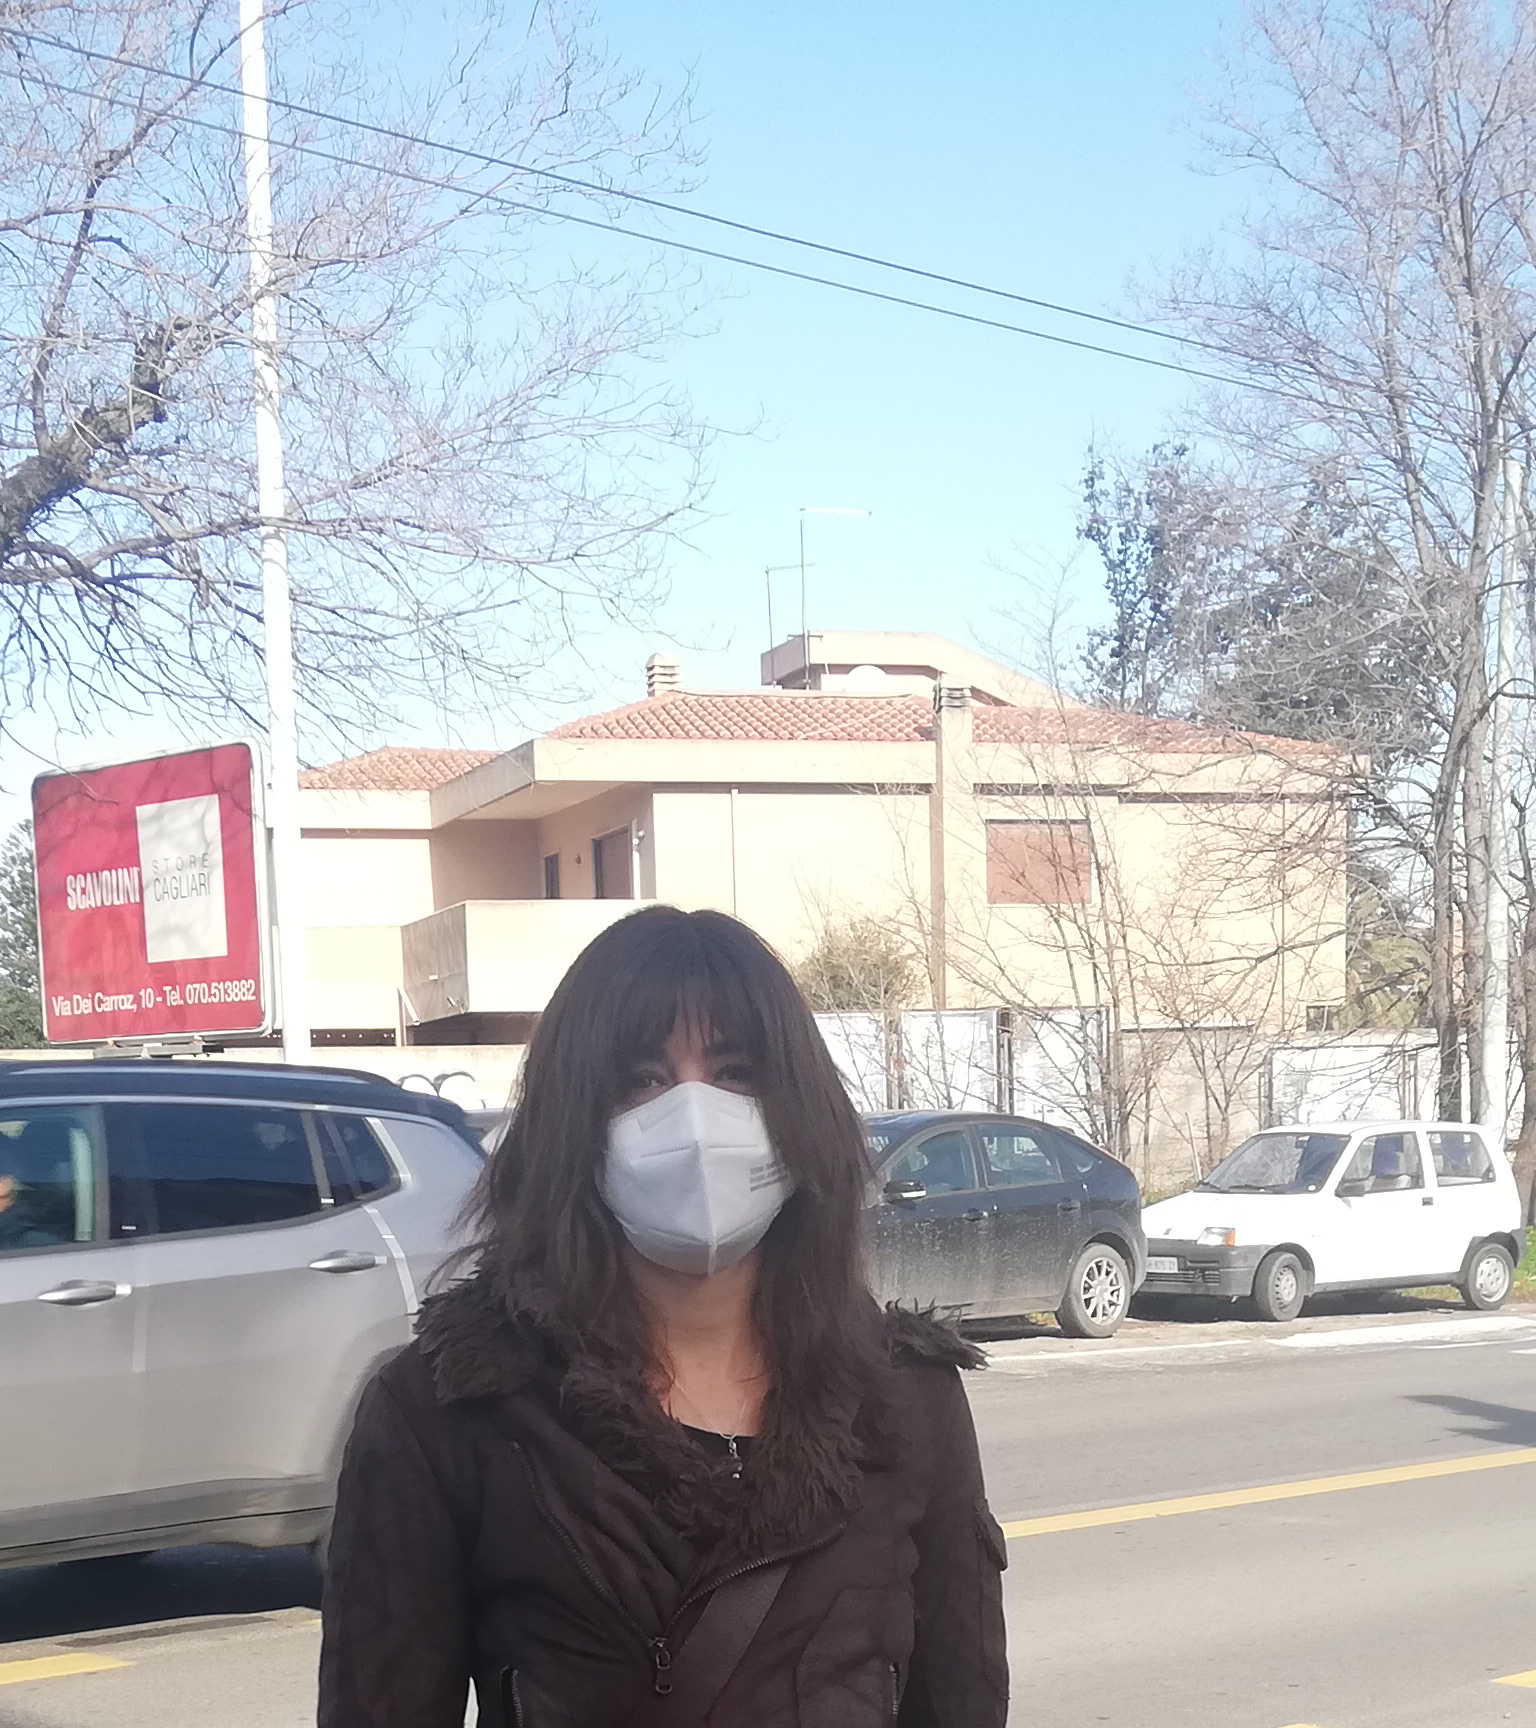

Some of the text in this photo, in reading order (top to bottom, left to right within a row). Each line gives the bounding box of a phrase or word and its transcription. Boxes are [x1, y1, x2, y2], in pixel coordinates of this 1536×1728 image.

[152, 852, 210, 874] STORE
[66, 866, 141, 911] SCAVOLINI
[152, 872, 212, 902] CAGLIARI
[52, 995, 72, 1017] Via
[73, 992, 93, 1015] Dei
[94, 991, 138, 1013] Carroz,
[139, 987, 154, 1009] 10
[163, 985, 184, 1007] Tel.
[186, 978, 256, 1005] 070.513882
